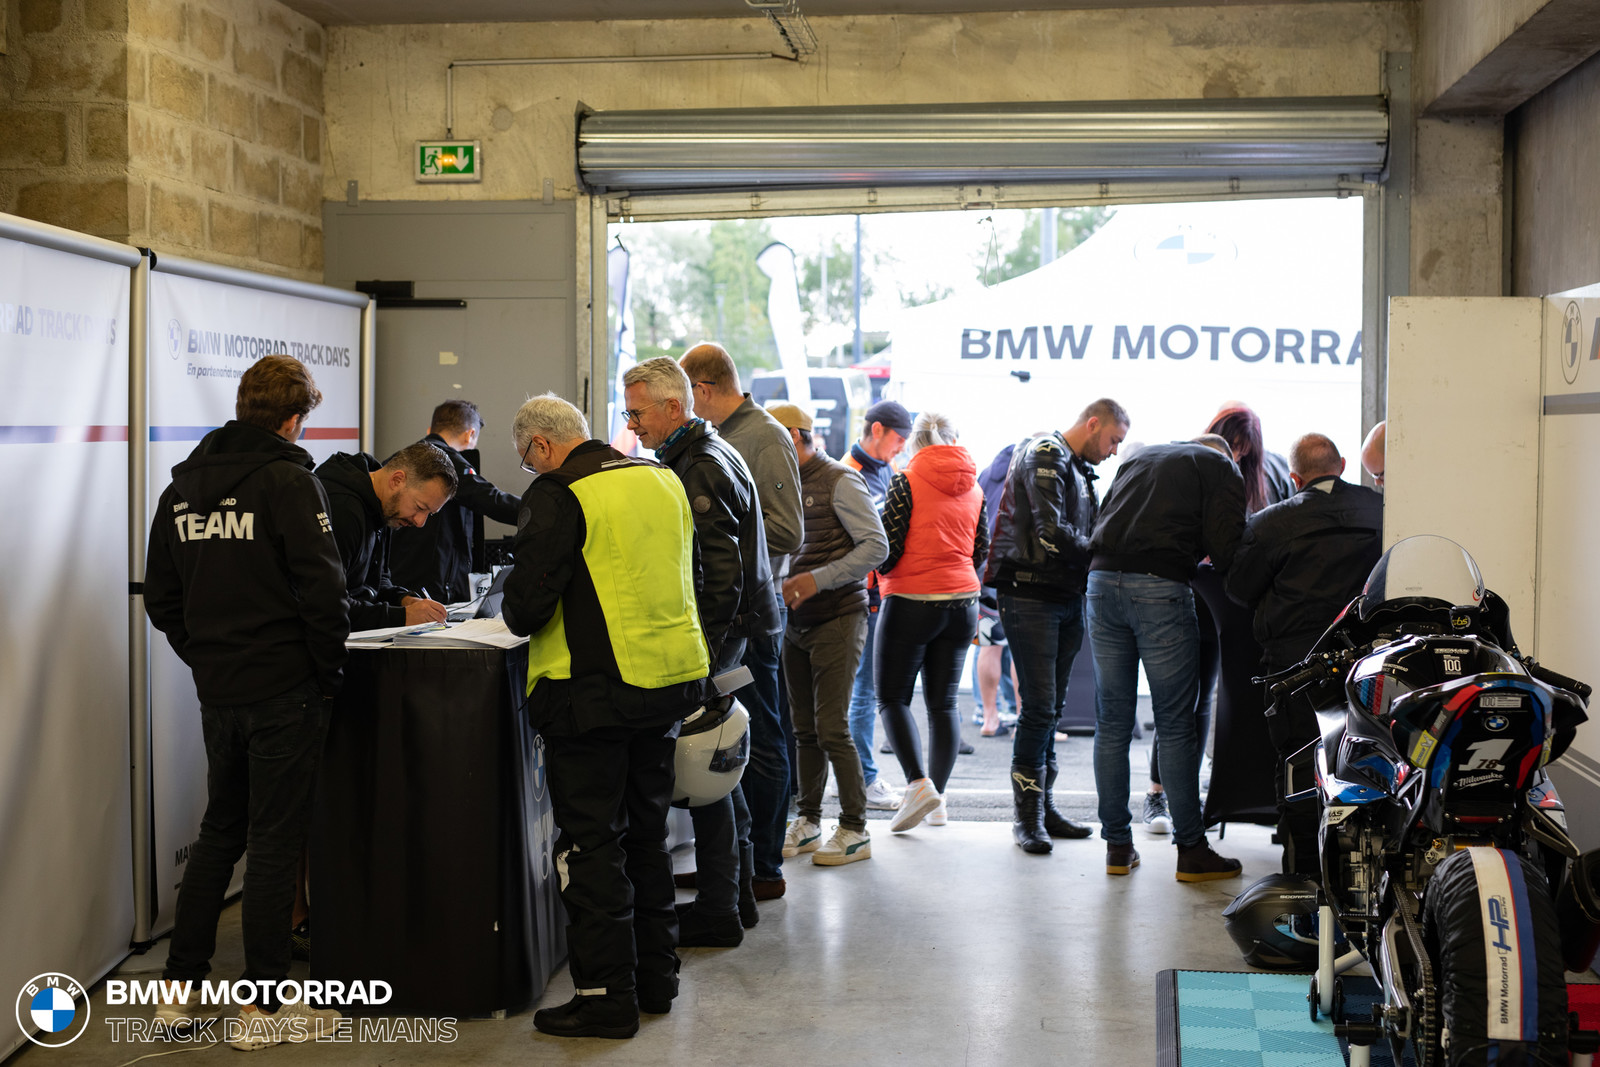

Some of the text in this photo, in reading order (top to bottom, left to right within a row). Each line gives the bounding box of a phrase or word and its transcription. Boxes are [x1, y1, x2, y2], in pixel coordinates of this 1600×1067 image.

[38, 308, 81, 340] TRACK
[187, 329, 350, 368] BMW MOTORRAD TRACK DAYS
[960, 325, 1093, 360] BMW
[187, 363, 196, 376] En
[175, 511, 254, 542] TEAM
[1443, 659, 1462, 672] 100
[1458, 739, 1514, 771] 1
[1475, 759, 1500, 769] 78
[1459, 772, 1504, 787] Milwaukee
[1488, 898, 1512, 952] HP
[1500, 957, 1509, 1024] BMW Motorrad
